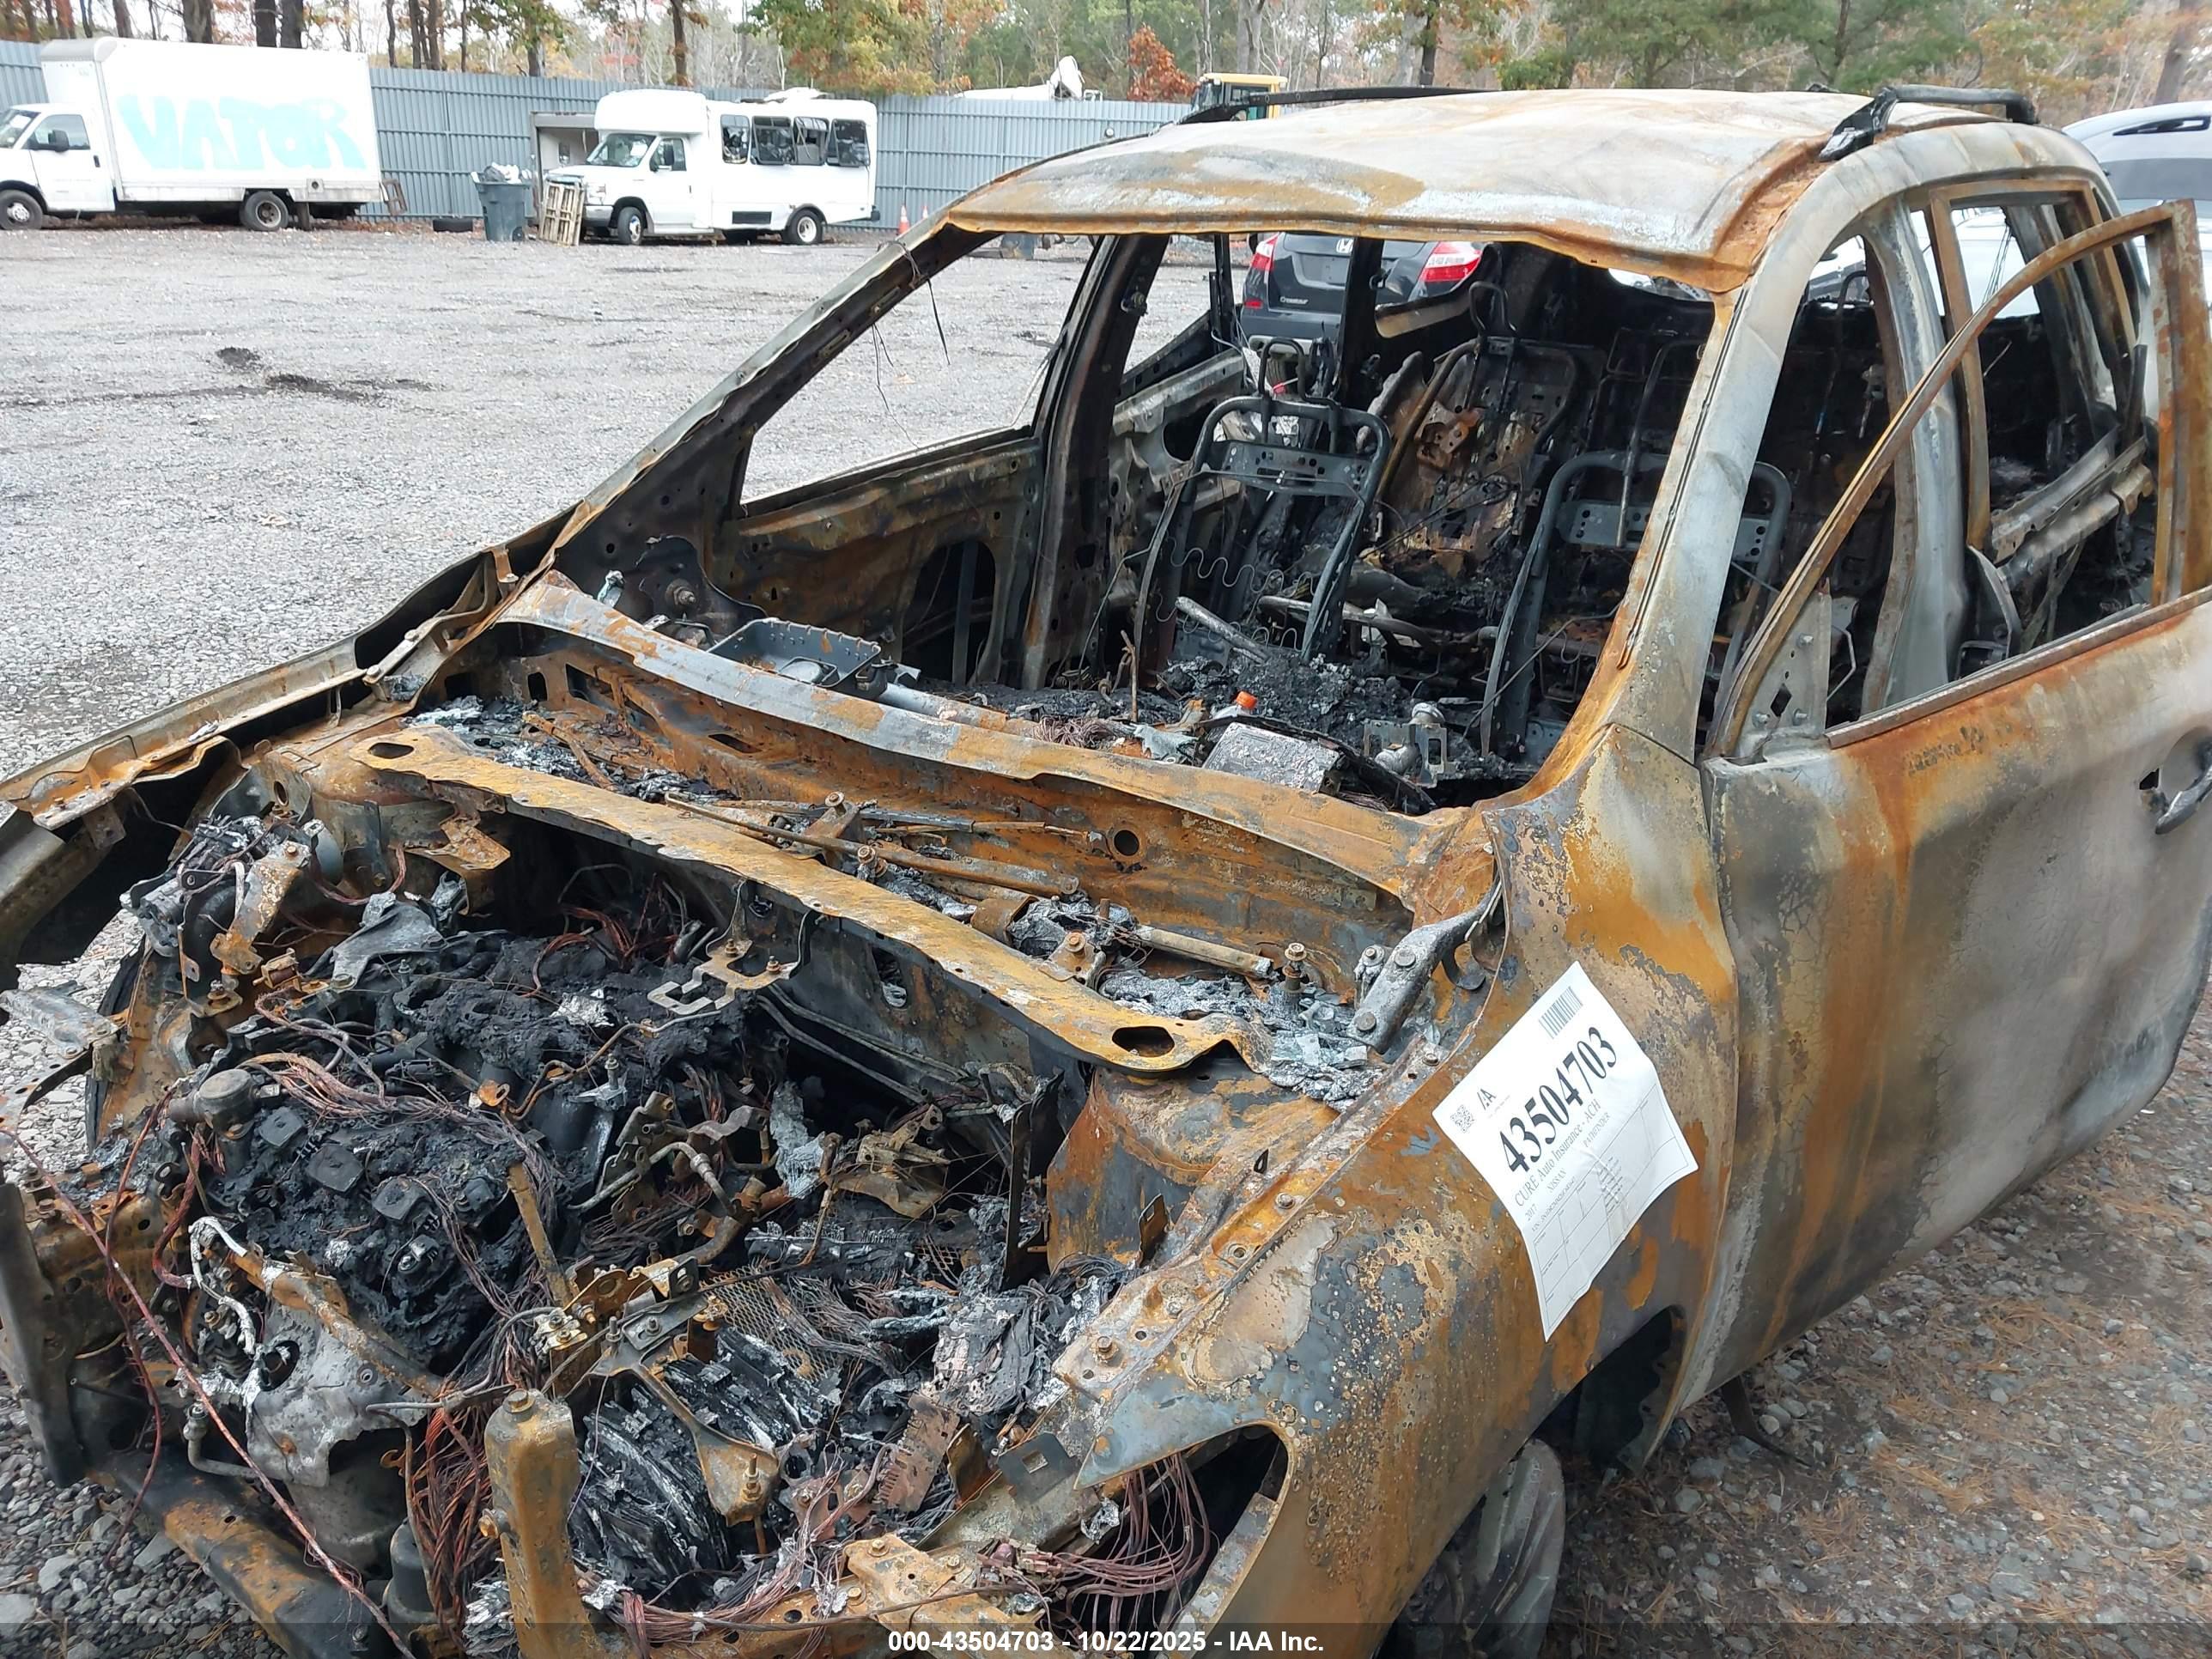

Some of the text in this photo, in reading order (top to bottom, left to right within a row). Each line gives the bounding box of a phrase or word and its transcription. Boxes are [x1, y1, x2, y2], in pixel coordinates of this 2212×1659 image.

[1499, 1026, 1616, 1173] 43504703
[1515, 1174, 1540, 1206] CURE
[1536, 1158, 1555, 1182] Auto
[1551, 1123, 1583, 1162] Insurance
[1584, 1097, 1601, 1124] ACH
